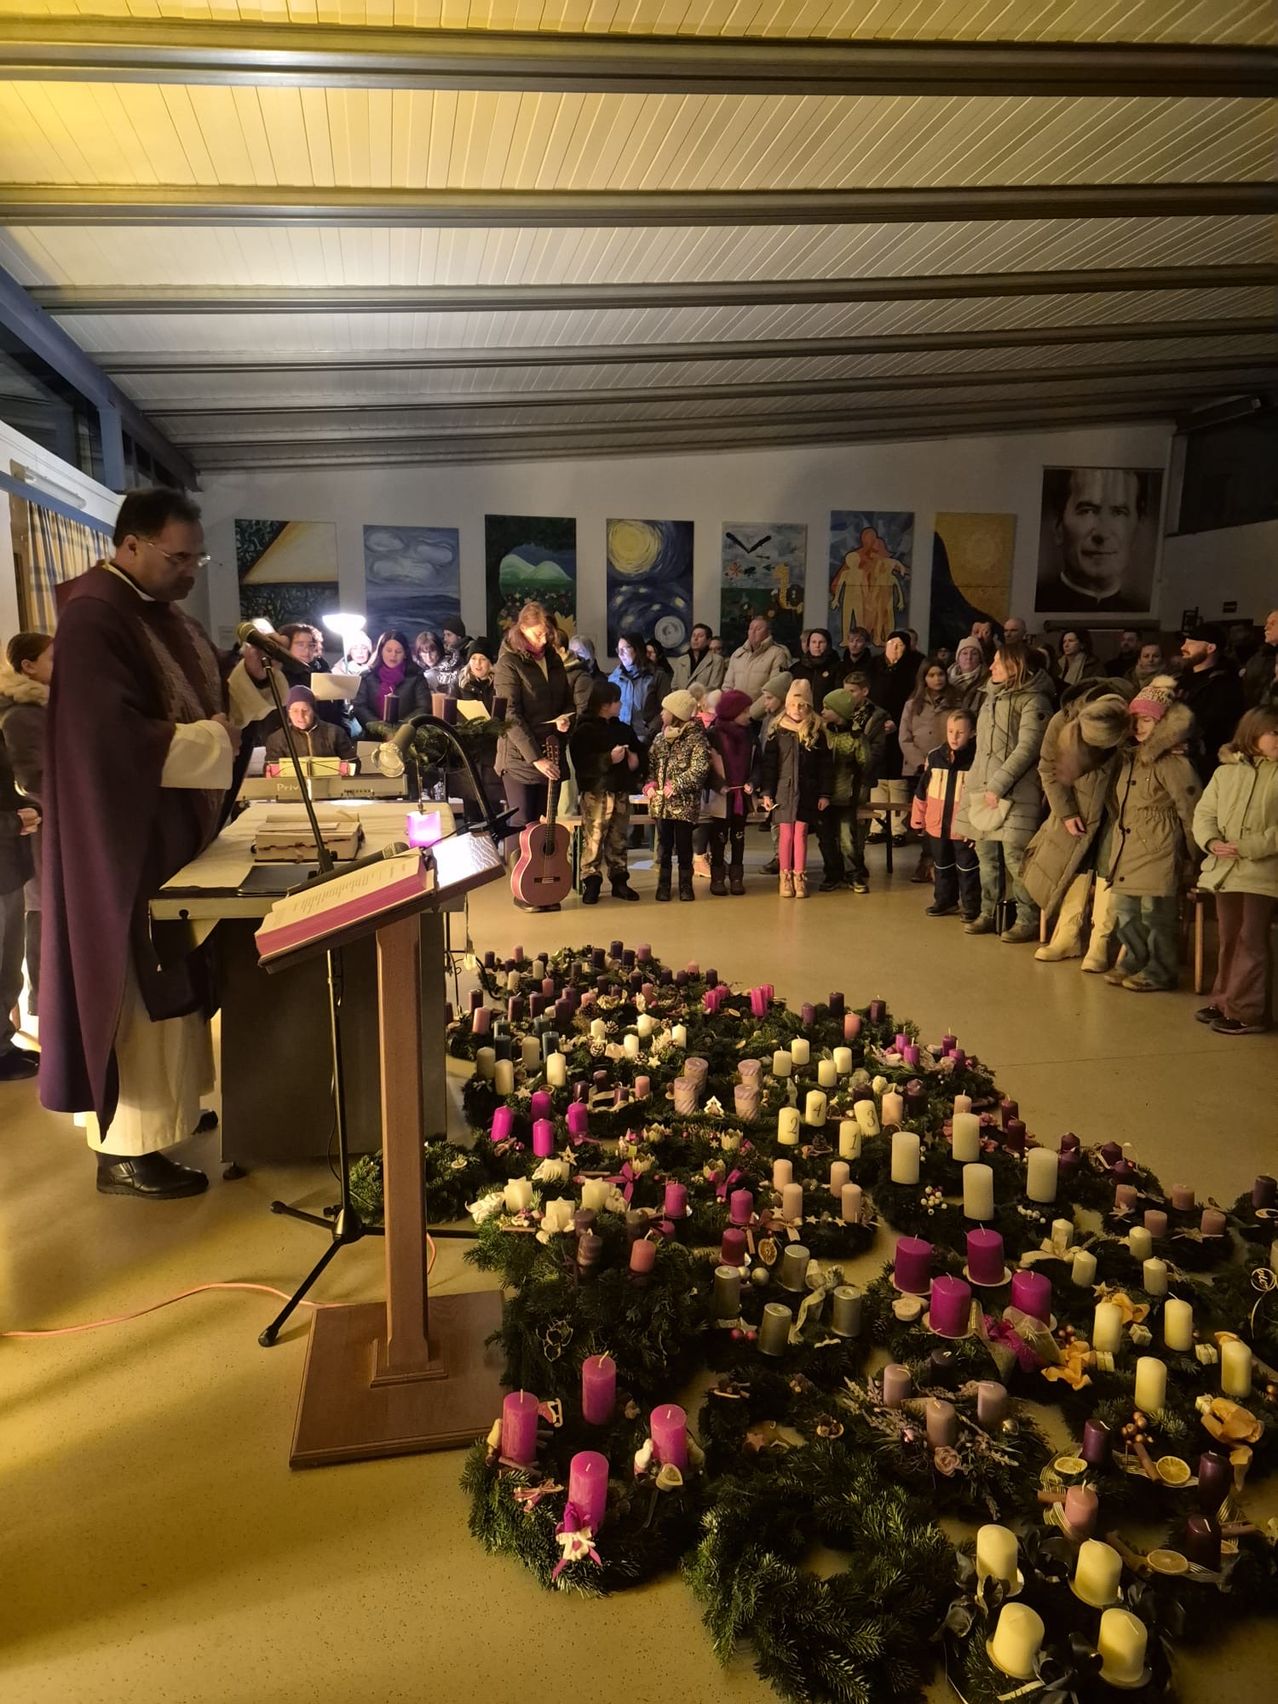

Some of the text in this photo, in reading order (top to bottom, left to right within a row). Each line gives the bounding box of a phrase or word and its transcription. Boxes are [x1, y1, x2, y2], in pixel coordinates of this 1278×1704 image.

[277, 783, 300, 791] Priv
[813, 1103, 822, 1118] 4
[867, 1110, 875, 1127] 3
[787, 1117, 797, 1134] 2
[850, 1133, 857, 1150] 1
